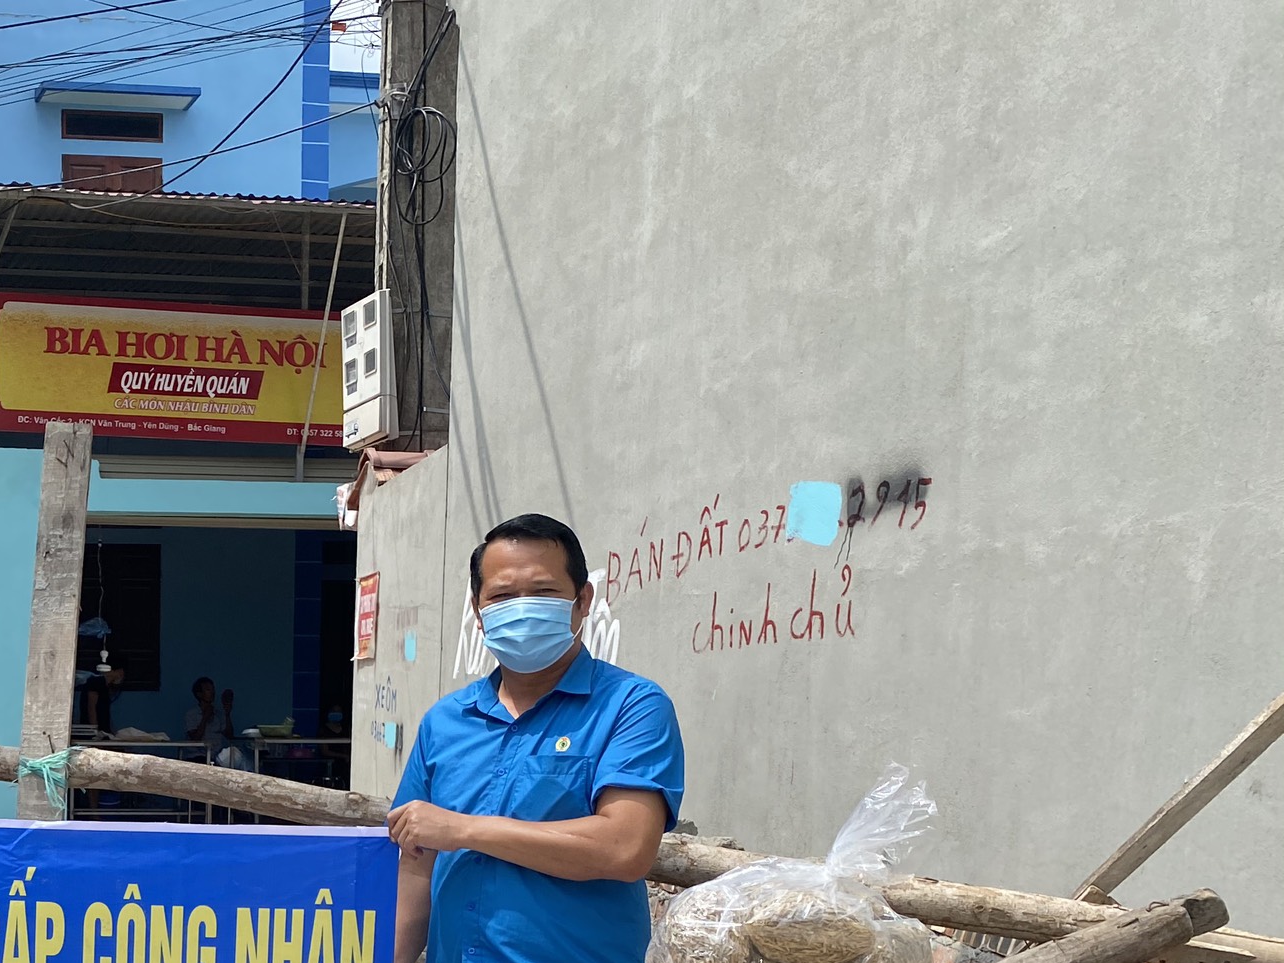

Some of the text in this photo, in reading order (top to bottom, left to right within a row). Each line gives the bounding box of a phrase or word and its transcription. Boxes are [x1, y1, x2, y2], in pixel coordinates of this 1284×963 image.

[43, 326, 327, 375] BIA HƠI HÀ NỘI
[120, 368, 250, 398] QUÝ HUYỀN QUÁN
[114, 396, 255, 415] CÁC MÓN NHẬU BÌNH DÂN
[17, 415, 32, 424] ĐC:
[114, 419, 137, 431] Trung
[142, 420, 158, 429] Yên
[203, 424, 226, 434] Giang
[320, 429, 333, 437] 322
[605, 516, 663, 606] BÁN
[670, 494, 729, 578] ĐẤT
